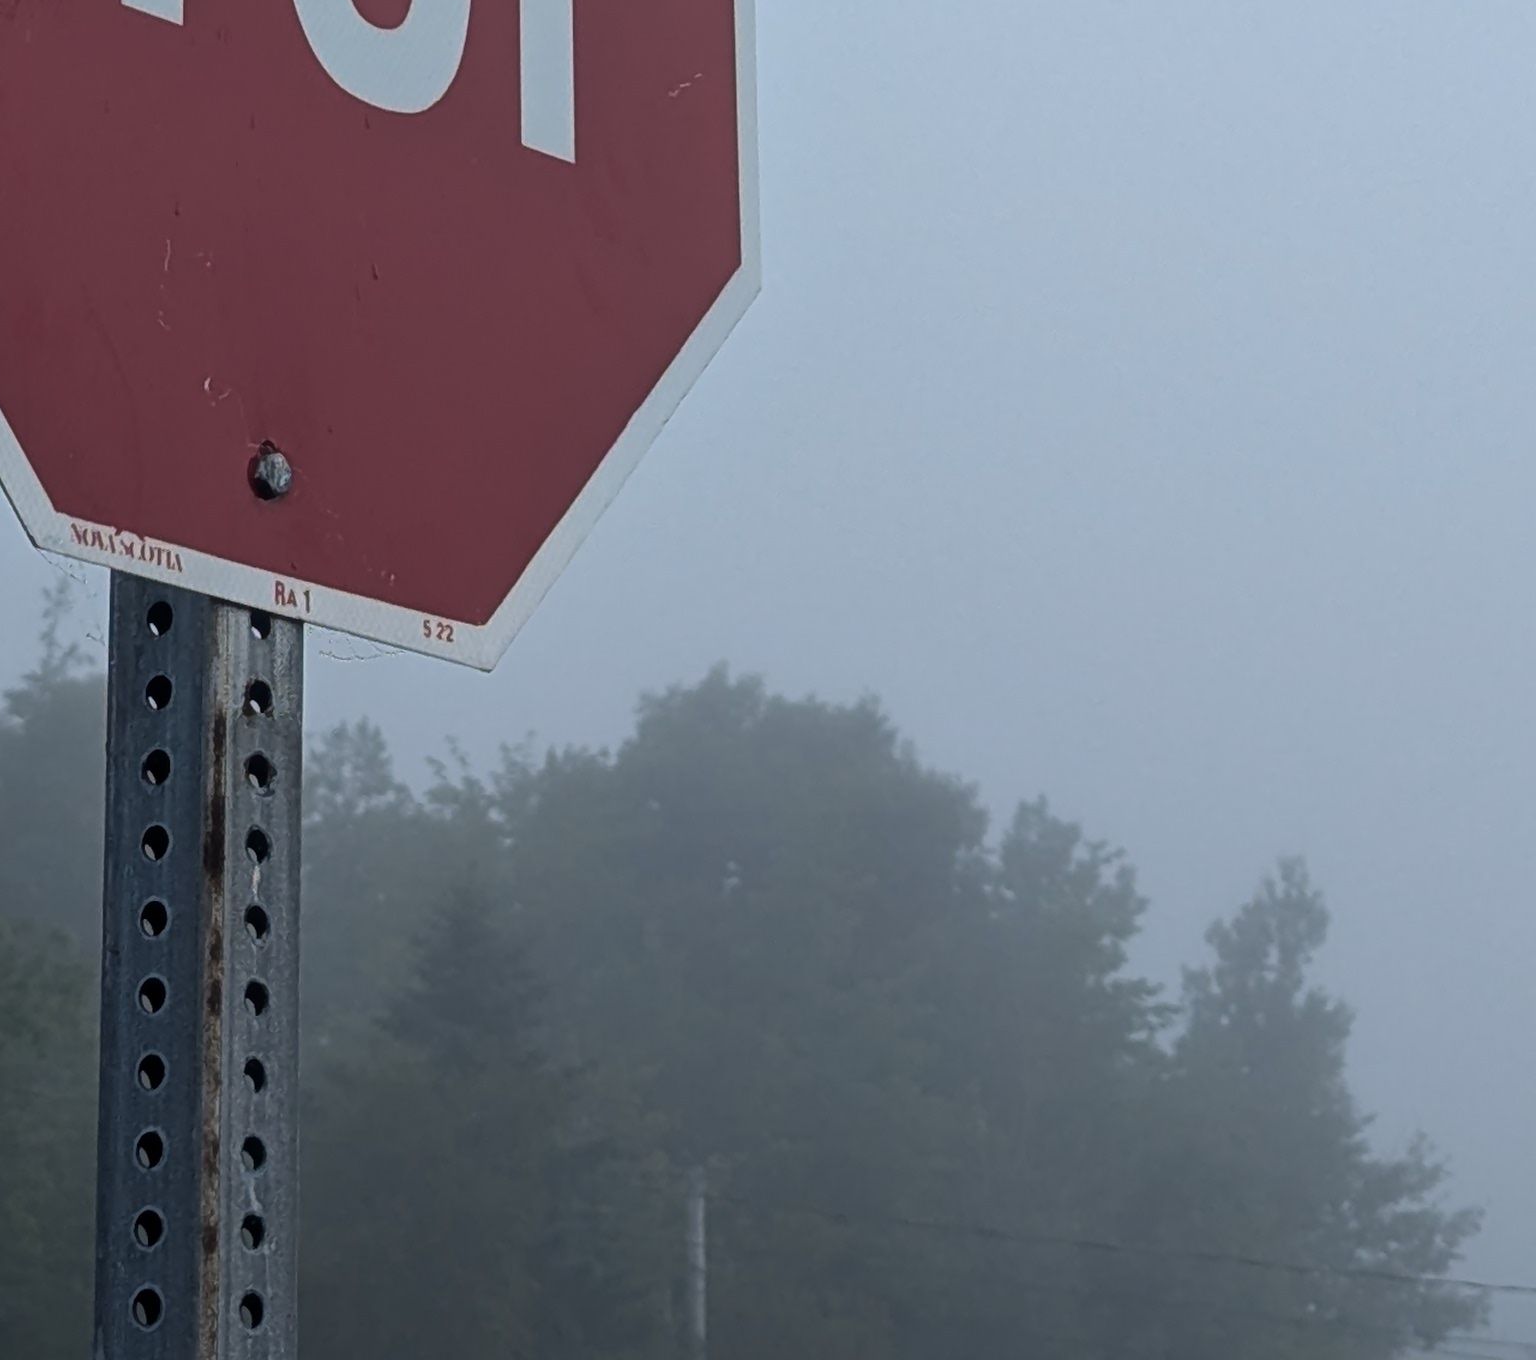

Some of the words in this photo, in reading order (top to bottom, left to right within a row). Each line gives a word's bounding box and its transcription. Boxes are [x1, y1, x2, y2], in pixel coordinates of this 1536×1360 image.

[71, 522, 117, 554] NOVA
[119, 538, 183, 573] SCOTIA
[436, 621, 455, 643] 22
